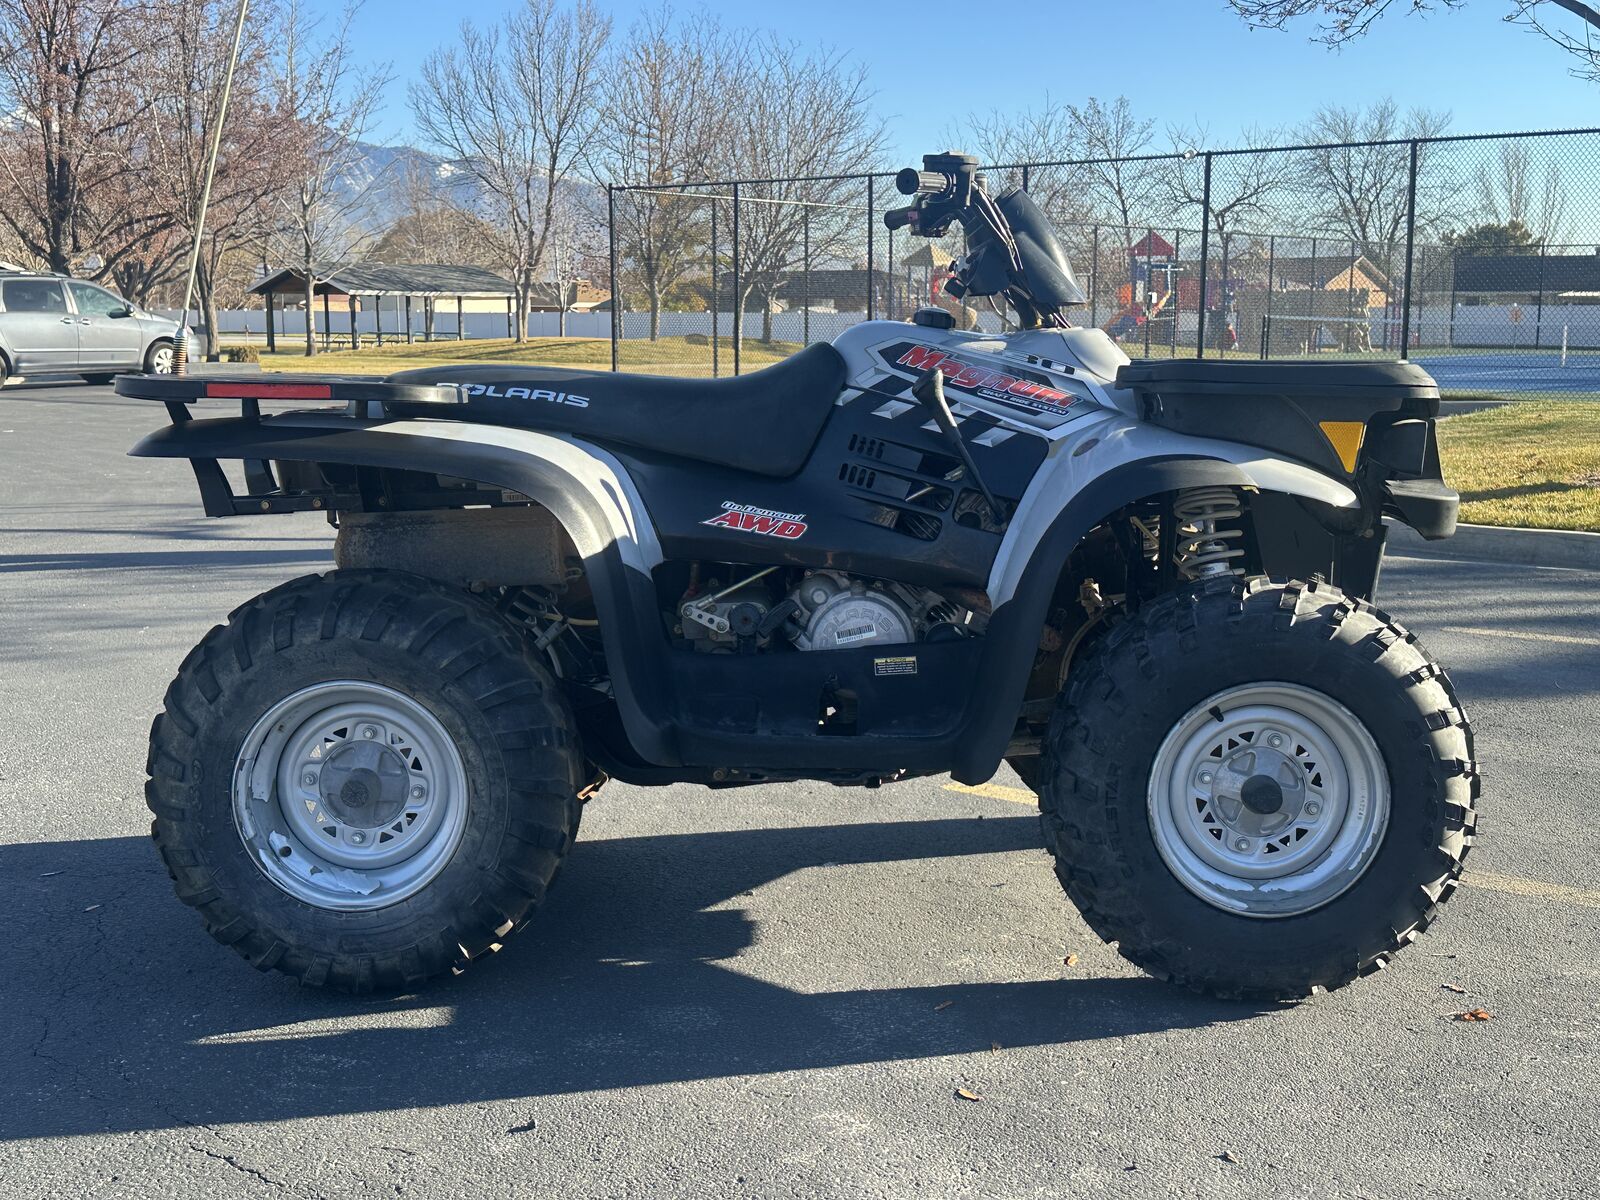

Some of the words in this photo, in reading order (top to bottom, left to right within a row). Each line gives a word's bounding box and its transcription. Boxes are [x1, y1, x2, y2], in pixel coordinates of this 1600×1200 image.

[897, 344, 1077, 408] Magnum
[981, 389, 1009, 400] SHAFT
[1031, 402, 1068, 416] SYSTEM
[699, 509, 808, 539] AWD
[720, 500, 742, 511] On
[742, 504, 807, 521] Demand
